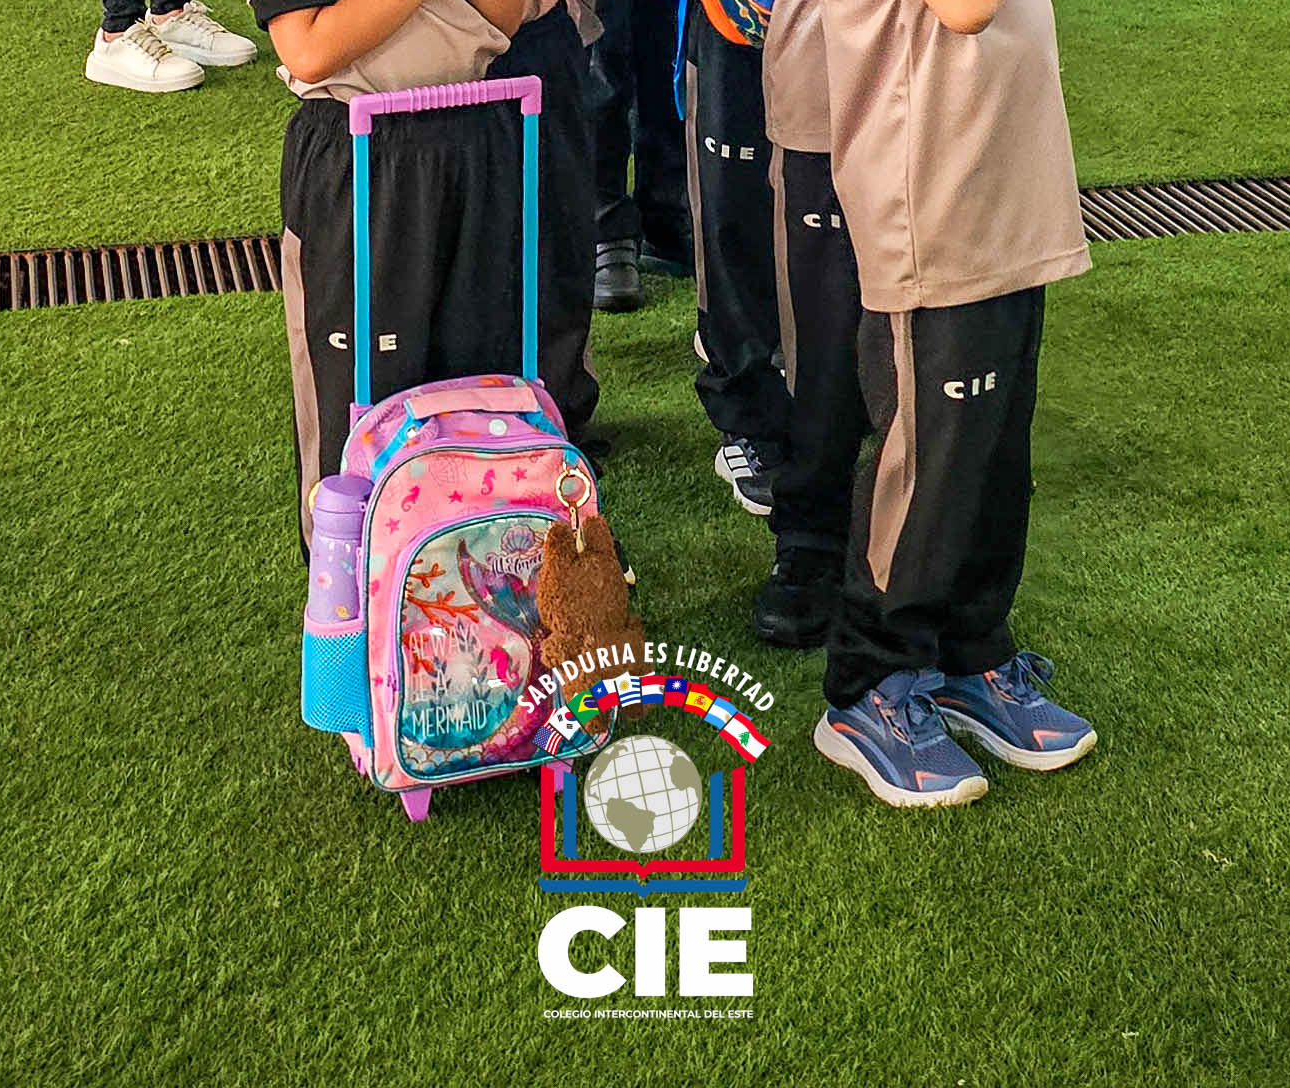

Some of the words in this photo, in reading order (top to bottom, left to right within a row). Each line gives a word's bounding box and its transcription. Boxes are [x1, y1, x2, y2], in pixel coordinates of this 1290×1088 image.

[704, 137, 755, 160] CIE
[803, 213, 841, 228] CI
[328, 332, 397, 351] CE
[943, 371, 997, 400] CIE
[409, 622, 482, 660] ALWAYS
[436, 668, 448, 700] A
[412, 699, 487, 737] MERMAID
